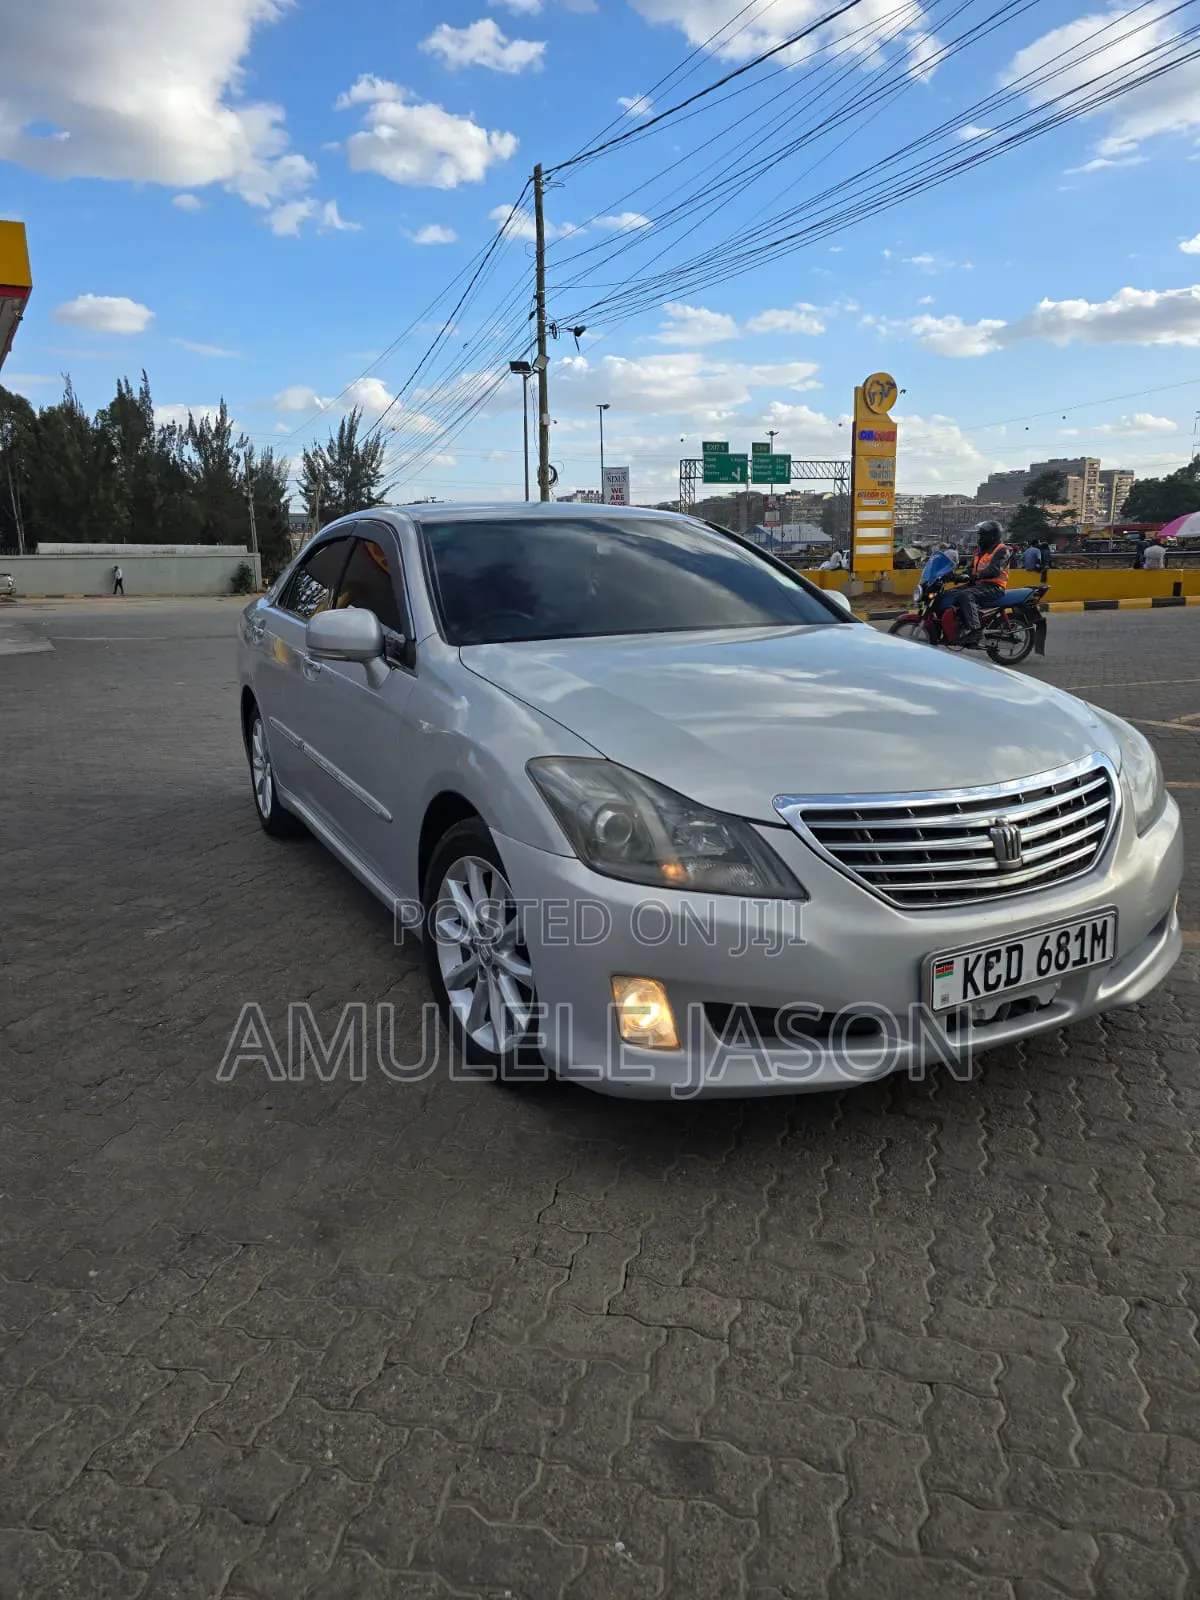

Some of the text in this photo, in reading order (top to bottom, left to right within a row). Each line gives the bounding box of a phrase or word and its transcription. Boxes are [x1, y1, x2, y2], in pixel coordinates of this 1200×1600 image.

[706, 443, 720, 451] EXIT
[962, 918, 1108, 1000] KCD 681M
